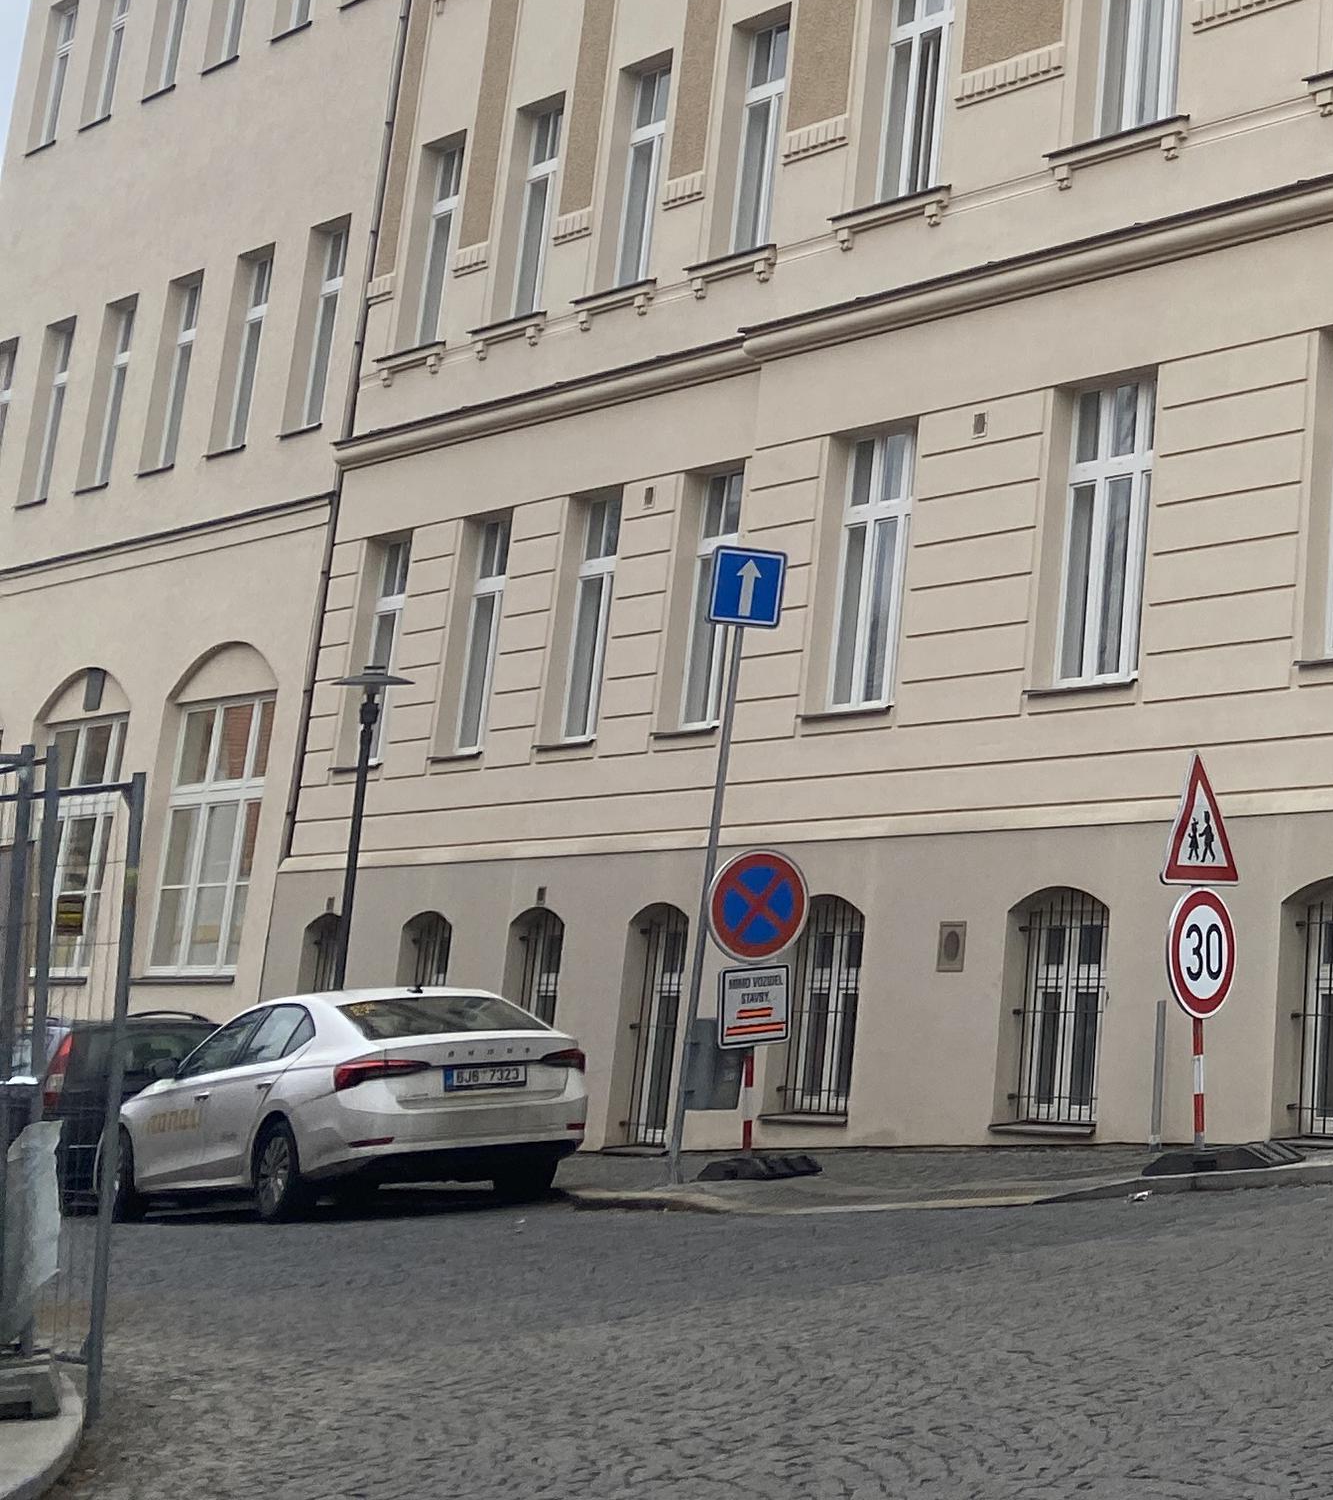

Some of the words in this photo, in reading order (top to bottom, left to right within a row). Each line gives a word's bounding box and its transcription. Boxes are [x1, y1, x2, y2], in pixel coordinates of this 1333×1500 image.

[1186, 923, 1223, 981] 30
[752, 975, 784, 988] VOZIDEL
[489, 1067, 520, 1081] 7323
